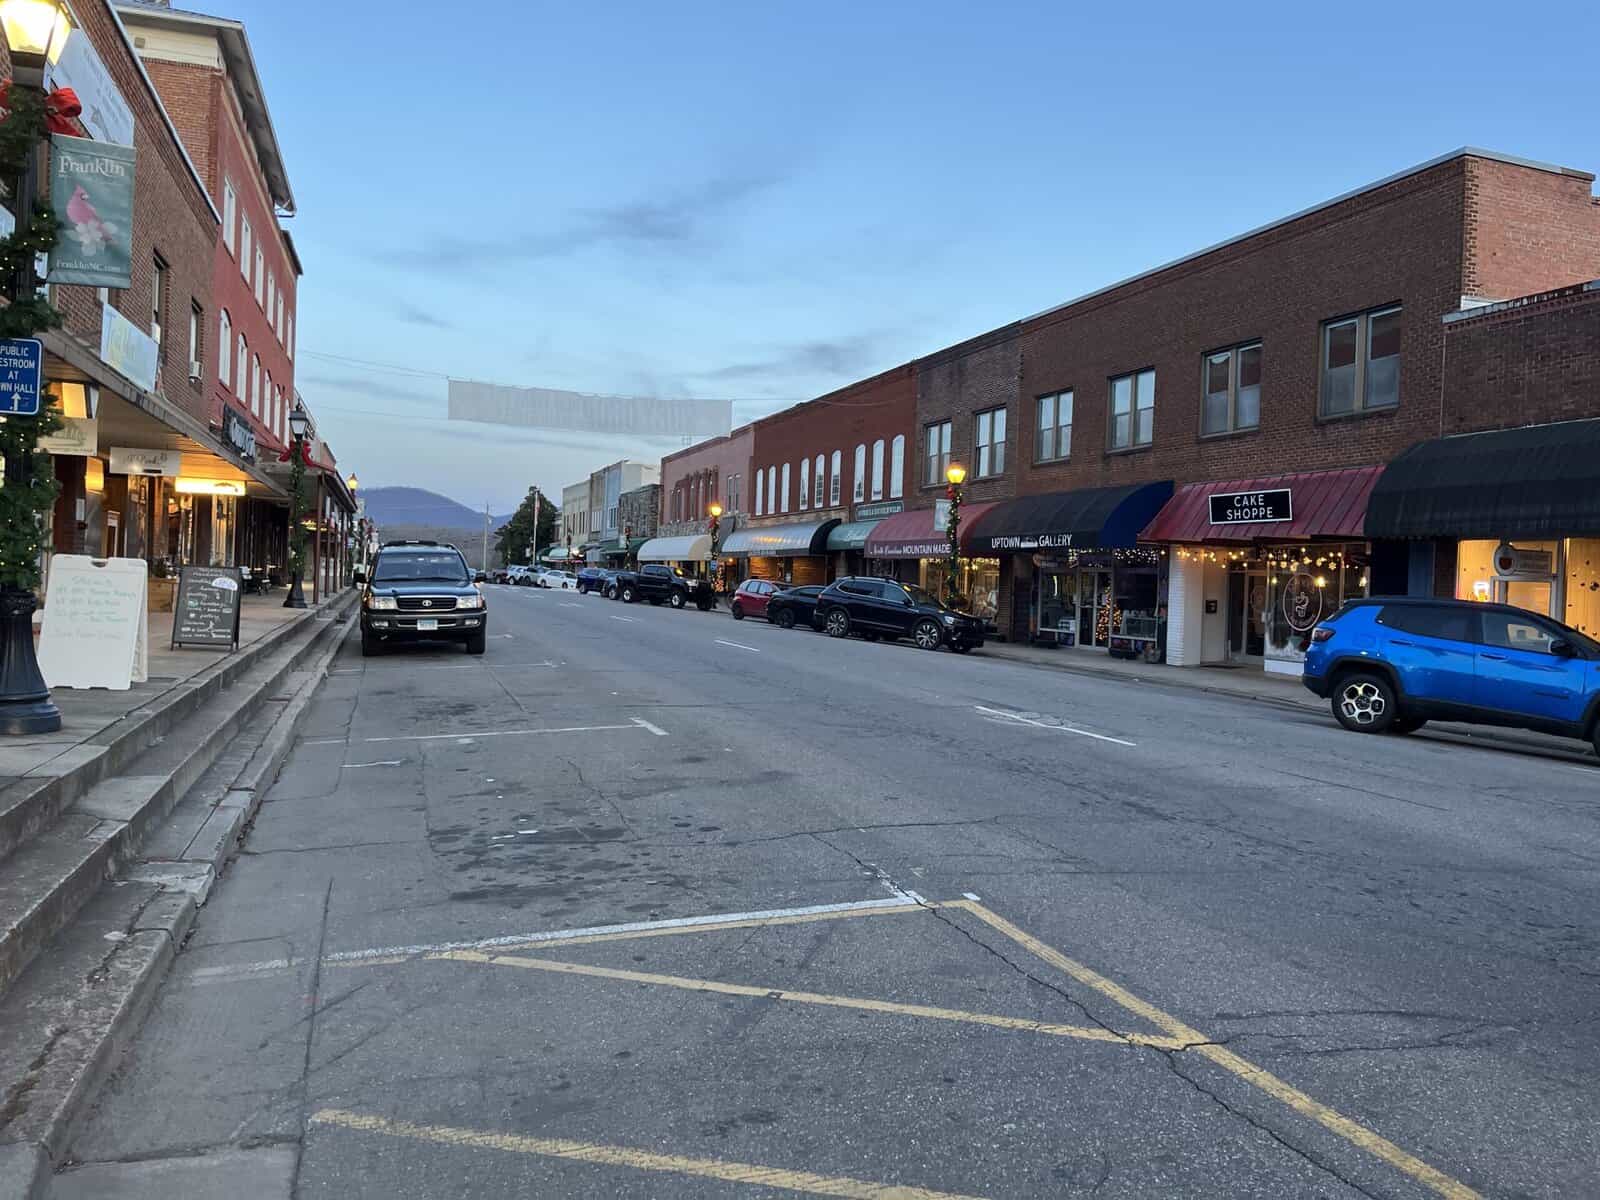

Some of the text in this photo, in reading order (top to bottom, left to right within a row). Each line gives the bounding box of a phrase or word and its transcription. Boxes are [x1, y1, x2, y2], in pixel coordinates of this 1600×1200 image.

[57, 155, 125, 177] Franklin
[0, 345, 29, 357] PUBLIC
[0, 358, 35, 368] ESTROOM
[8, 370, 19, 380] AT
[0, 382, 34, 393] WN HALL
[1233, 494, 1265, 507] CAKE
[1226, 507, 1273, 520] SHOPPE
[991, 536, 1021, 549] UPTOWN
[1038, 534, 1072, 547] GALLERY
[902, 544, 933, 555] MOUNTAIN
[933, 543, 952, 554] MADE
